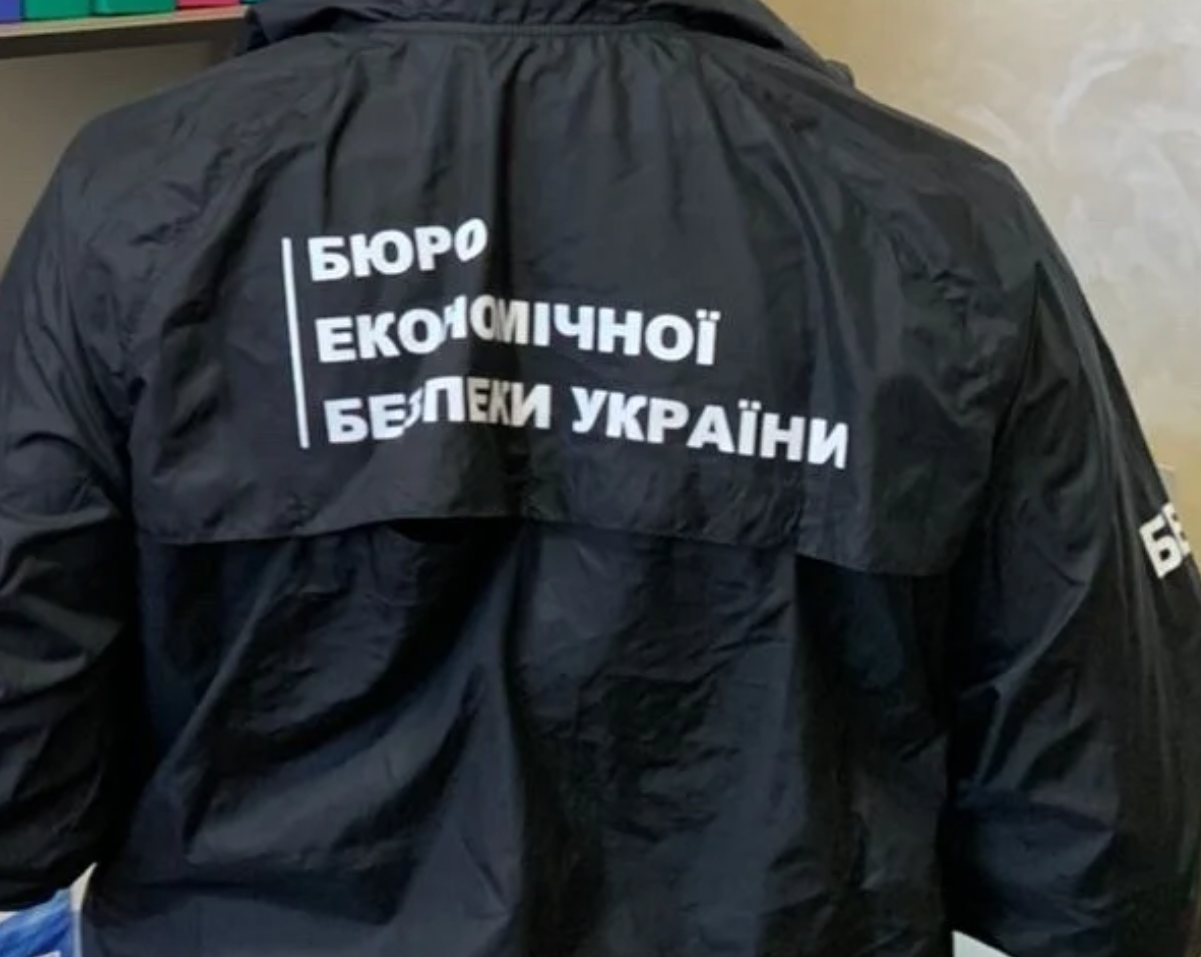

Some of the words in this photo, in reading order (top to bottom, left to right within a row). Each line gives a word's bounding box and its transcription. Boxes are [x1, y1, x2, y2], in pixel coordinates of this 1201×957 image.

[307, 217, 489, 282] БЮРО
[315, 294, 722, 366] ЕКОНОМІЧНОЇ
[571, 386, 850, 470] УКРАЇНИ
